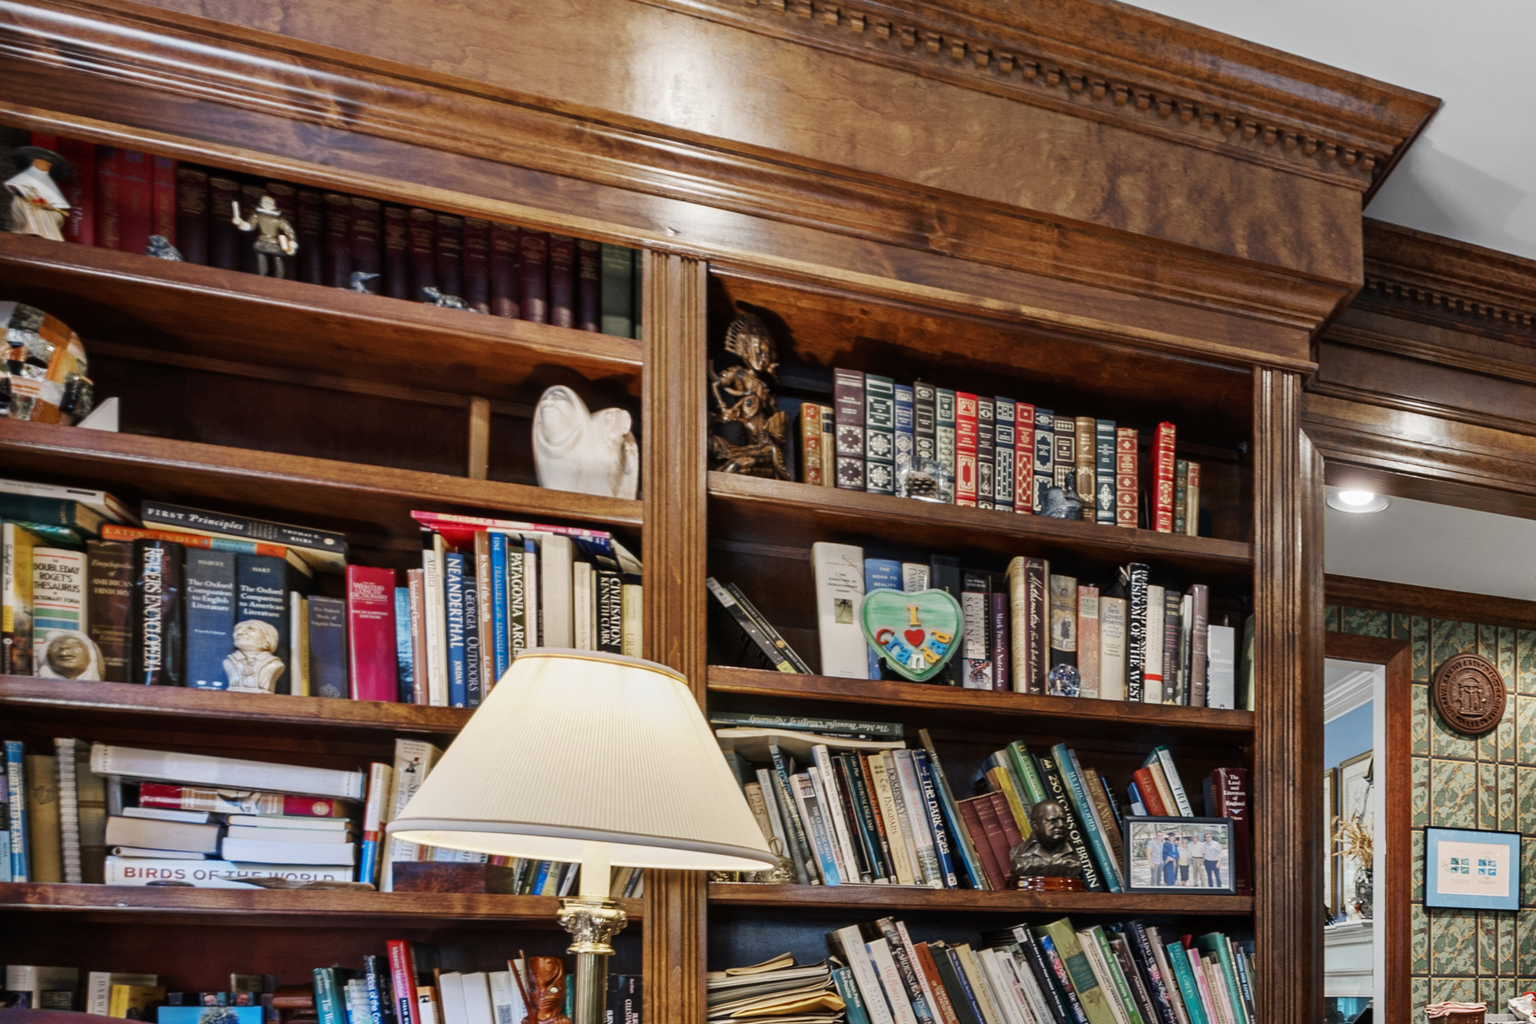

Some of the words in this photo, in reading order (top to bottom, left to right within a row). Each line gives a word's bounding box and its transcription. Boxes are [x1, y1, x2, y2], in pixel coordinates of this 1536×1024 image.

[147, 508, 184, 520] FIRST
[189, 513, 244, 530] Principles
[105, 527, 155, 540] EATING
[159, 532, 199, 545] INDIA
[290, 536, 313, 544] RICKS
[34, 562, 80, 575] DOUBLEDAY
[39, 572, 73, 583] ROGET'S
[34, 581, 80, 593] THESAURUS
[188, 586, 233, 596] Companion
[202, 581, 233, 590] Oxford
[257, 586, 283, 596] Oxford
[506, 551, 527, 617] PATAGONIA
[1131, 570, 1142, 619] WISDOM
[191, 602, 230, 611] Literature
[201, 595, 230, 604] English
[240, 593, 283, 603] Companion
[250, 602, 285, 611] American
[447, 558, 464, 648] NEANDERTHAL
[600, 577, 611, 616] KENNETH
[244, 609, 280, 618] Literature
[464, 589, 477, 630] GEORGIA
[610, 578, 621, 646] CIVILISATION
[908, 606, 920, 626] I
[142, 594, 163, 672] ENCYCLOPEDIA
[601, 618, 611, 645] CLARK
[964, 596, 975, 655] SCIENCE
[1131, 622, 1140, 638] OF
[466, 636, 479, 691] OUTDOORS
[1130, 643, 1140, 667] THE
[453, 660, 463, 685] JORDAN
[996, 653, 1005, 687] Notebooks
[1130, 670, 1140, 702] WEST
[818, 750, 833, 777] London
[921, 778, 935, 794] THE
[1047, 772, 1063, 794] 250
[748, 790, 766, 817] 1215
[812, 805, 820, 816] THE
[1067, 770, 1087, 802] MYTHIC
[1080, 802, 1099, 832] WOODS
[862, 805, 875, 831] ENGLAND
[927, 799, 944, 828] DARK
[809, 815, 820, 837] MICHAEL
[814, 815, 827, 842] CLASSICAL
[814, 837, 825, 856] GRANT
[1068, 829, 1083, 847] OF
[821, 842, 833, 864] GREEKS
[124, 867, 186, 879] BIRDS
[194, 870, 220, 880] OF
[1073, 845, 1101, 889] BRITAIN
[844, 969, 853, 980] The
[902, 937, 920, 969] CAPTURED
[914, 968, 930, 994] HARVEST
[847, 979, 858, 994] Welsh
[907, 981, 927, 1011] PLANTS
[1067, 991, 1078, 1002] The
[1131, 974, 1148, 1003] American
[1179, 974, 1197, 1000] GARDEN
[322, 1000, 332, 1012] The
[851, 992, 863, 1008] Peaks
[933, 987, 941, 997] THE
[937, 996, 947, 1012] UNITED
[937, 984, 950, 1005] COMMON
[945, 1004, 956, 1021] WEEDS
[1124, 997, 1135, 1013] BOOK
[895, 1000, 912, 1024] Across
